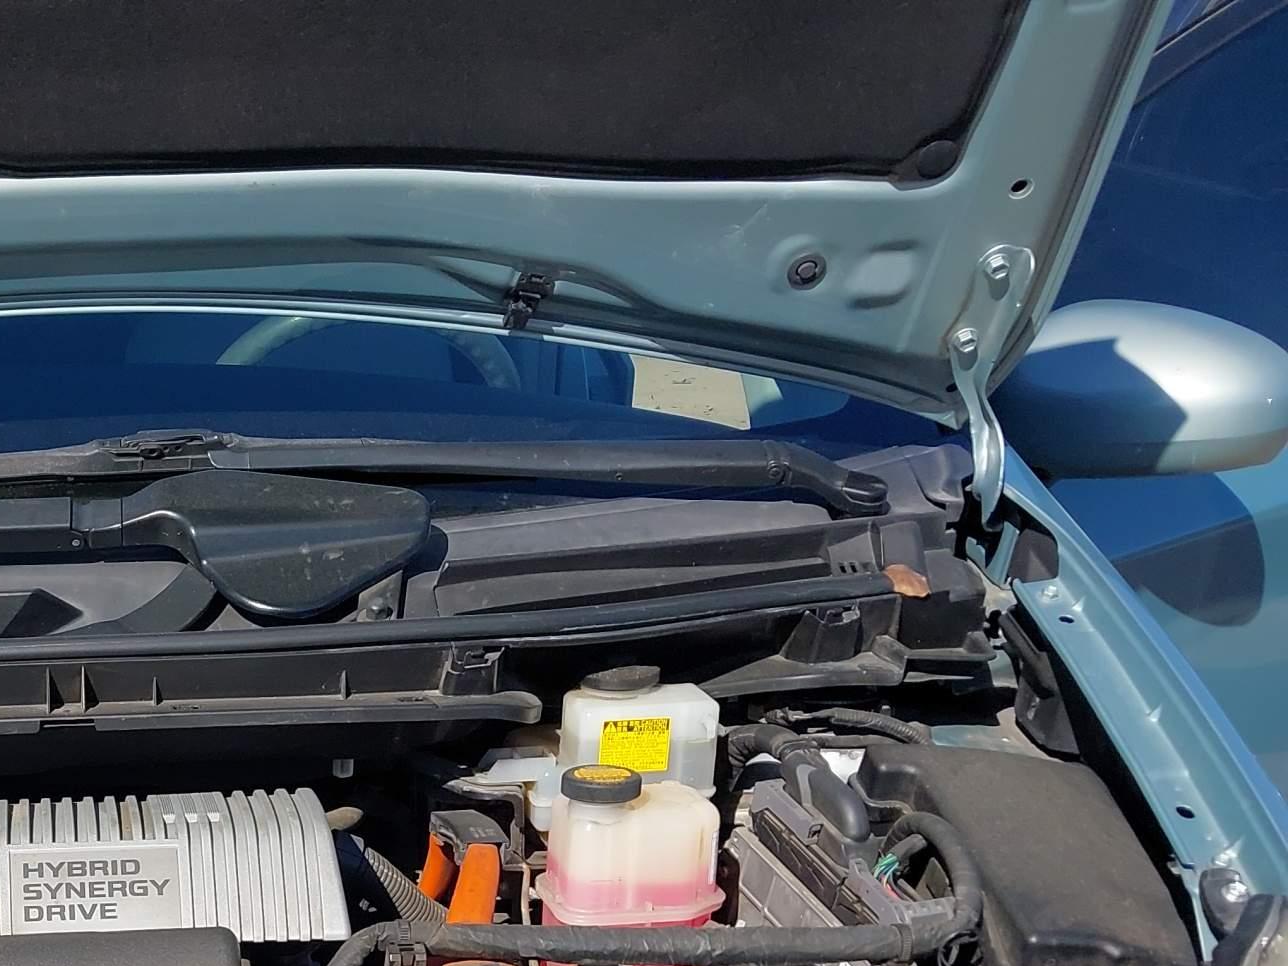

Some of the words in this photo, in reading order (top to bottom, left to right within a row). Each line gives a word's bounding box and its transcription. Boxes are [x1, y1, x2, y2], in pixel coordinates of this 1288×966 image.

[23, 860, 140, 879] HYBRID
[23, 879, 171, 900] SYNERGY
[24, 903, 118, 922] DRIVE
